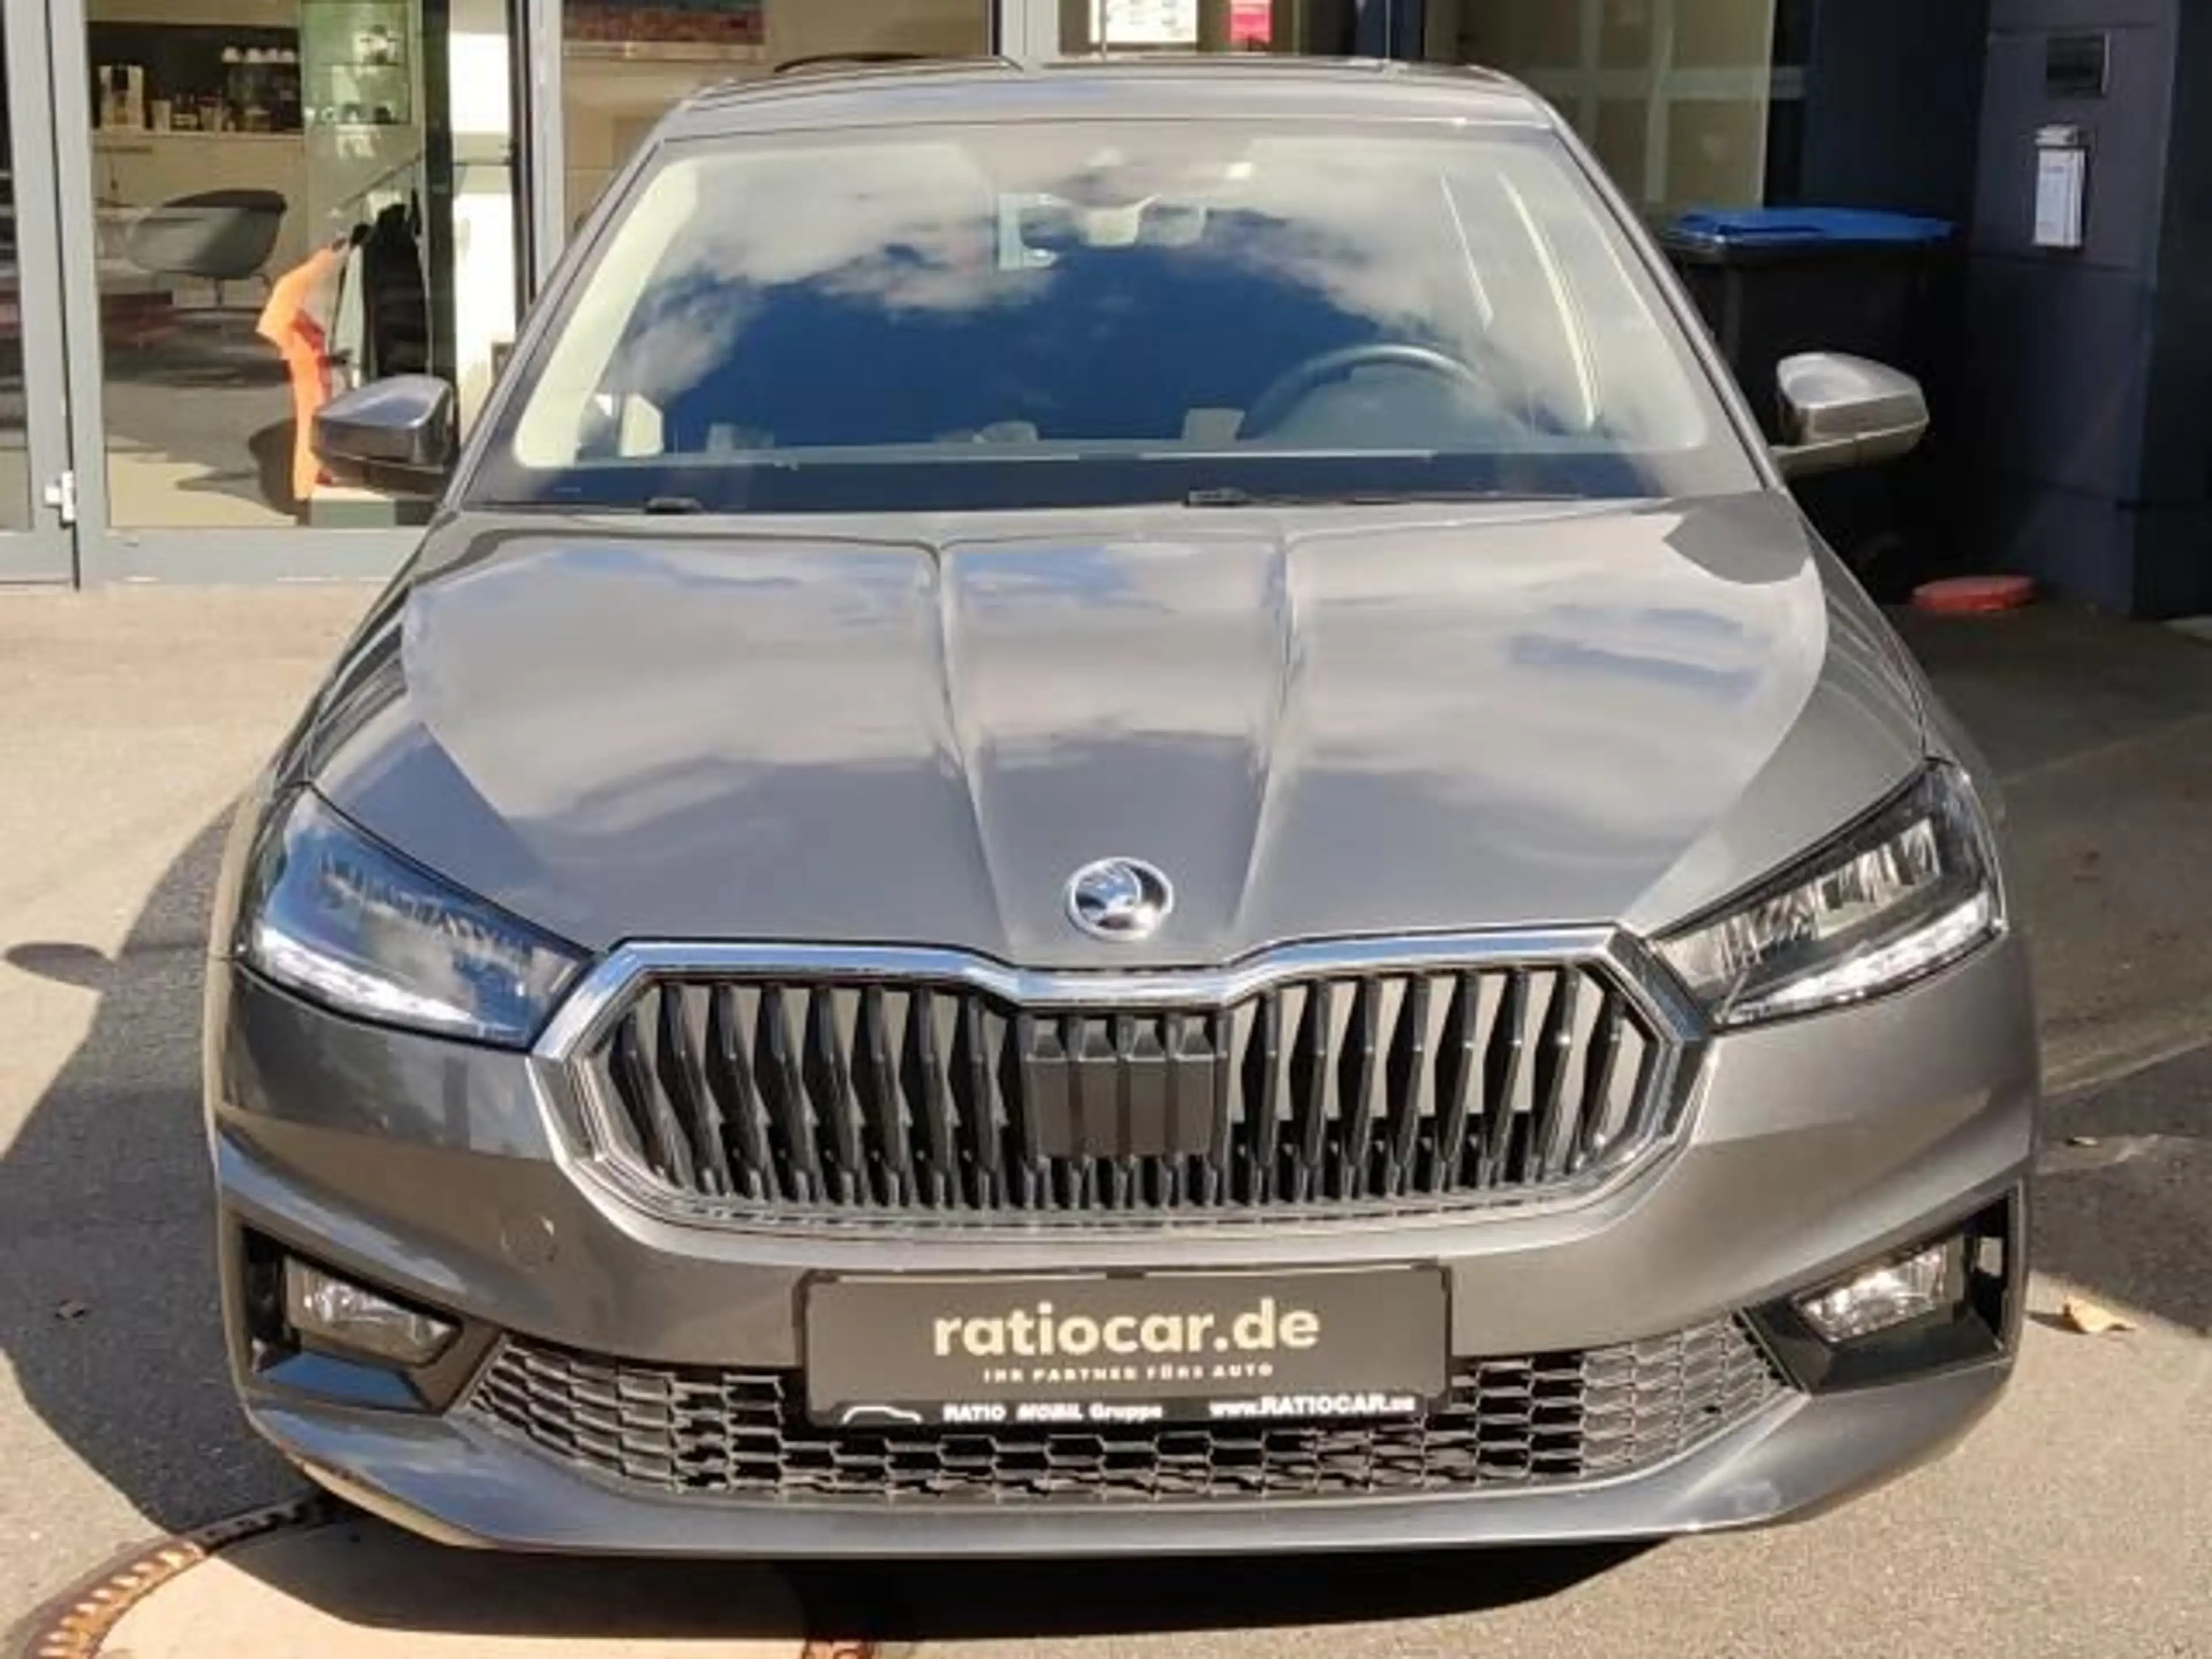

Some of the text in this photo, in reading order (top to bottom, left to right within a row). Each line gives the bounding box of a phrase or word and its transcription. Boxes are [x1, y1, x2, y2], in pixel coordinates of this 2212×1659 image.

[934, 1296, 1320, 1355] ratiocar.de
[1032, 1365, 1138, 1382] PARTNER
[1211, 1361, 1274, 1378] AUTO
[942, 1402, 1007, 1422] RATIO
